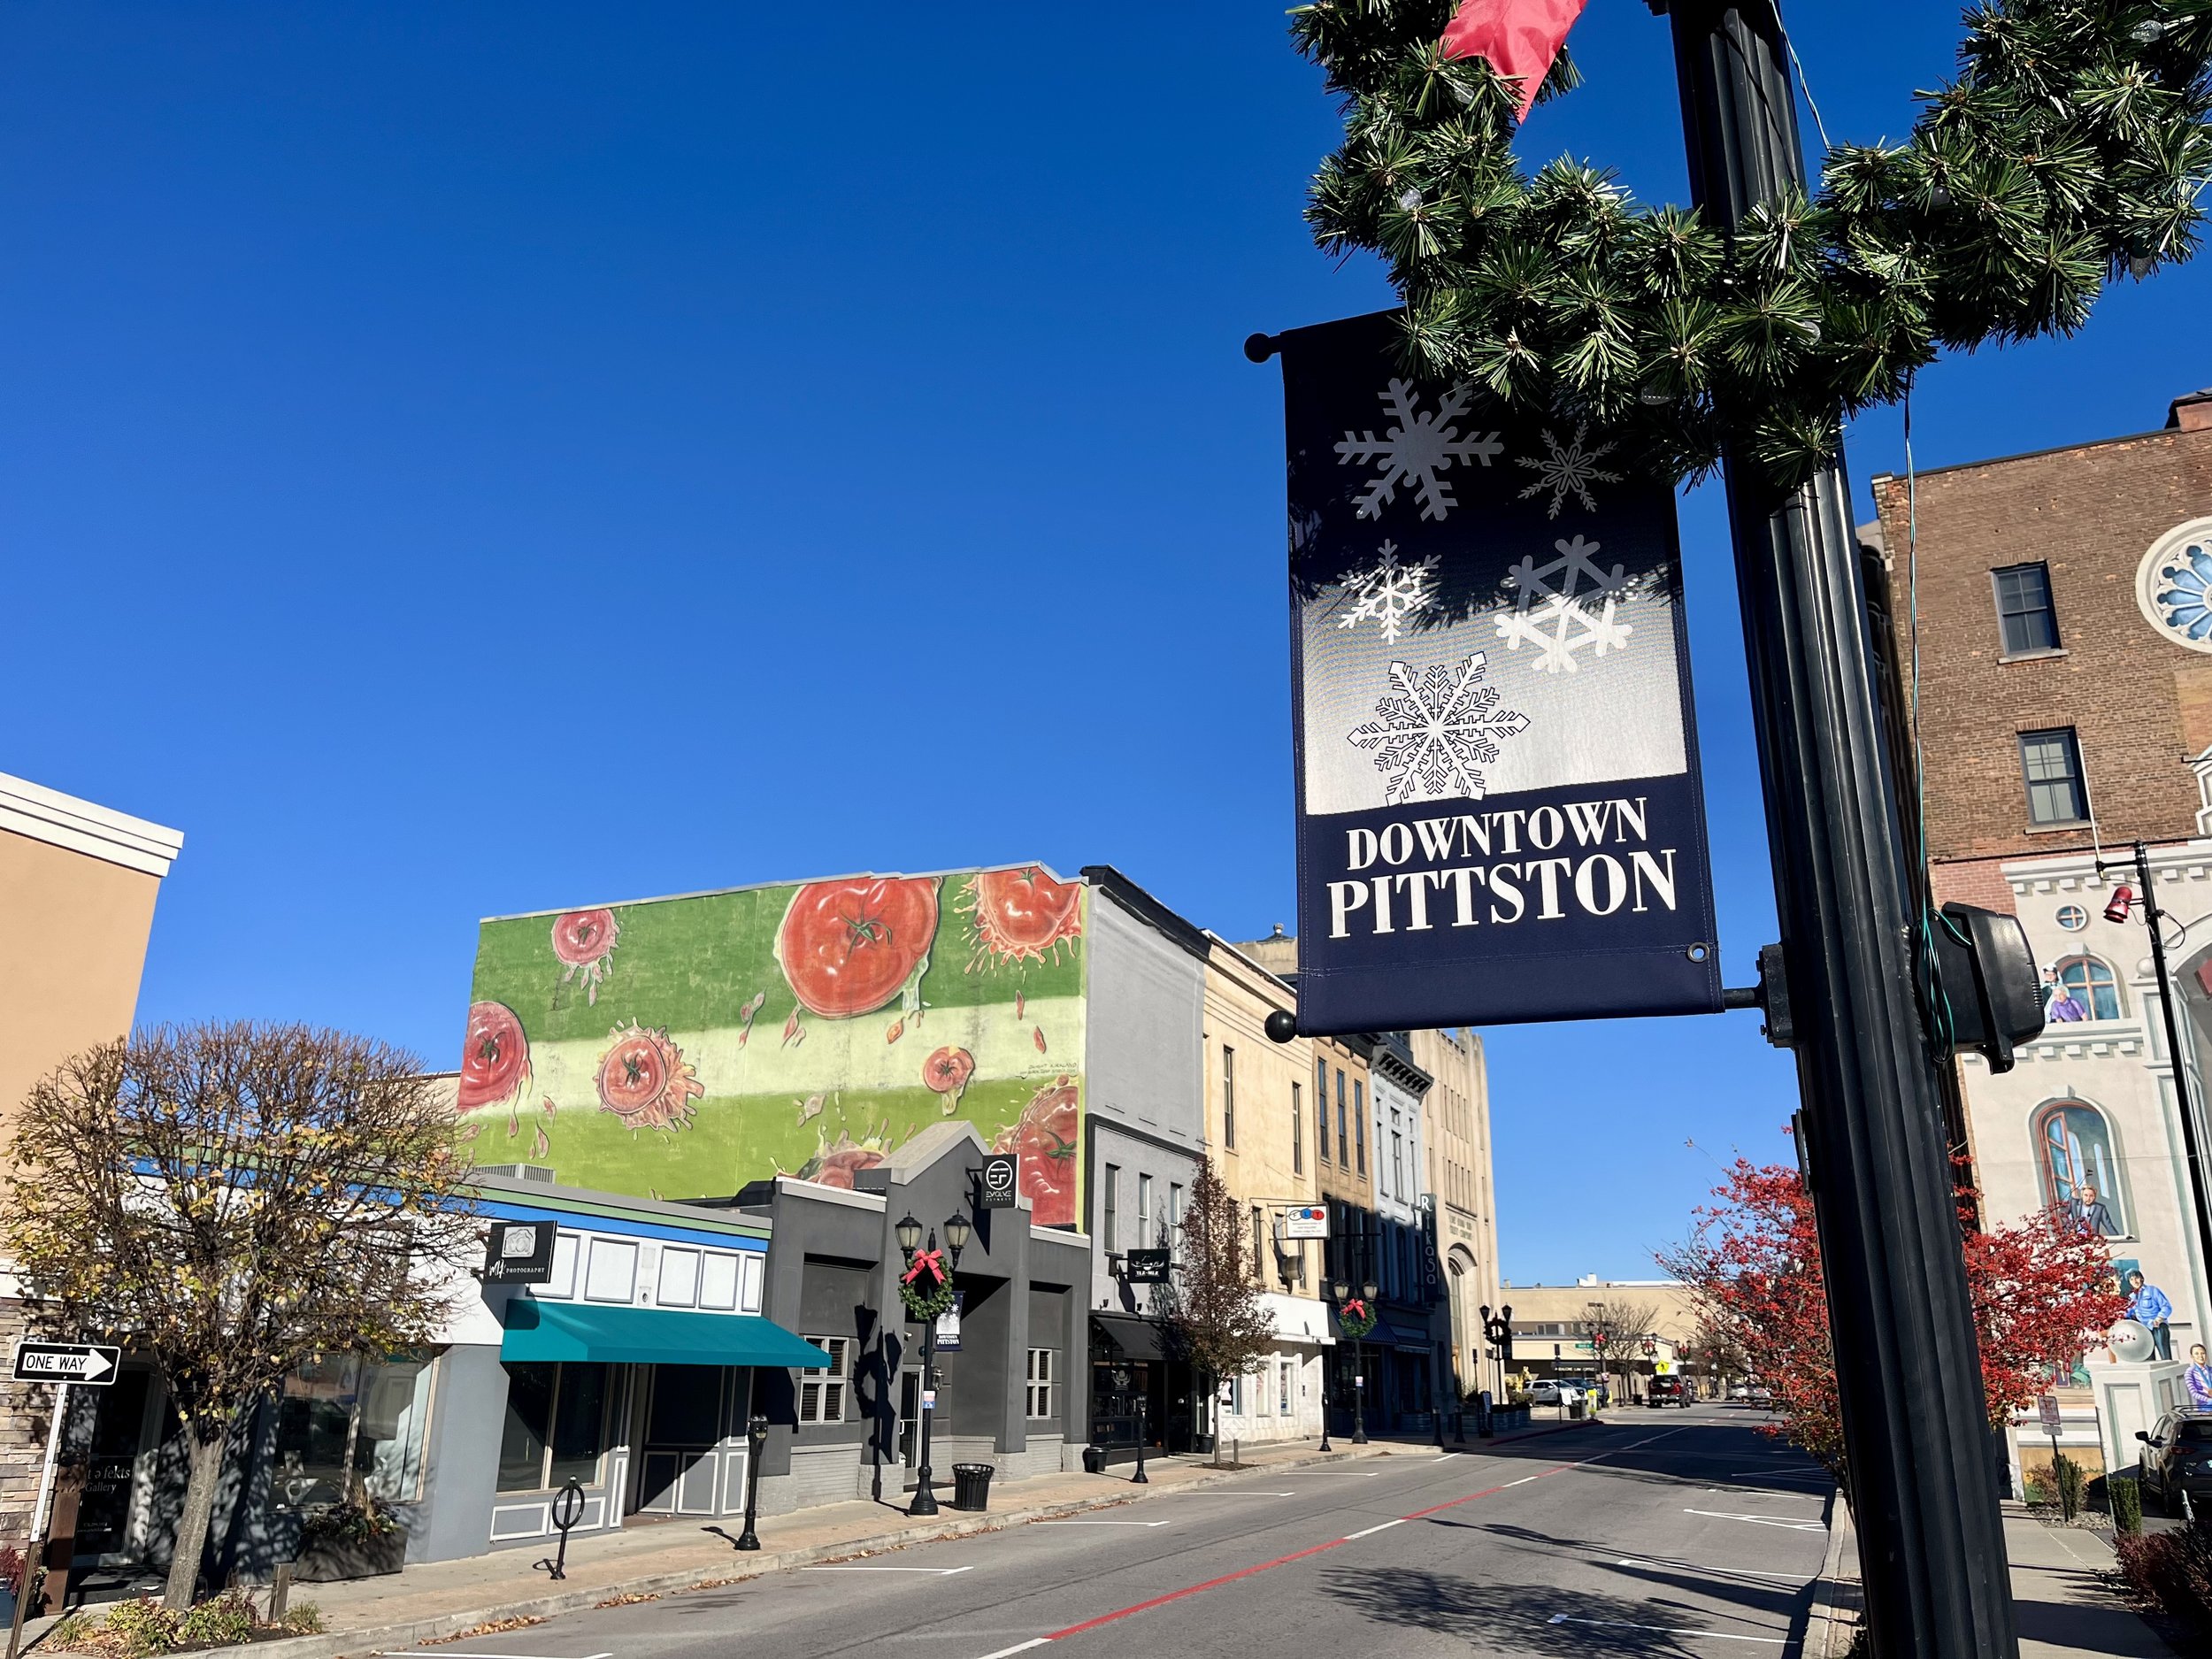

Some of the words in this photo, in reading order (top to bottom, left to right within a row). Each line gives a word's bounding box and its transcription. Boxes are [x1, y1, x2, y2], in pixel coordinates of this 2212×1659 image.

[1346, 796, 1648, 871] DOWNTOWN
[1326, 849, 1678, 939] PITTSTON
[26, 1355, 54, 1370] ONE
[59, 1356, 87, 1371] WAY
[85, 1481, 117, 1494] Gallery
